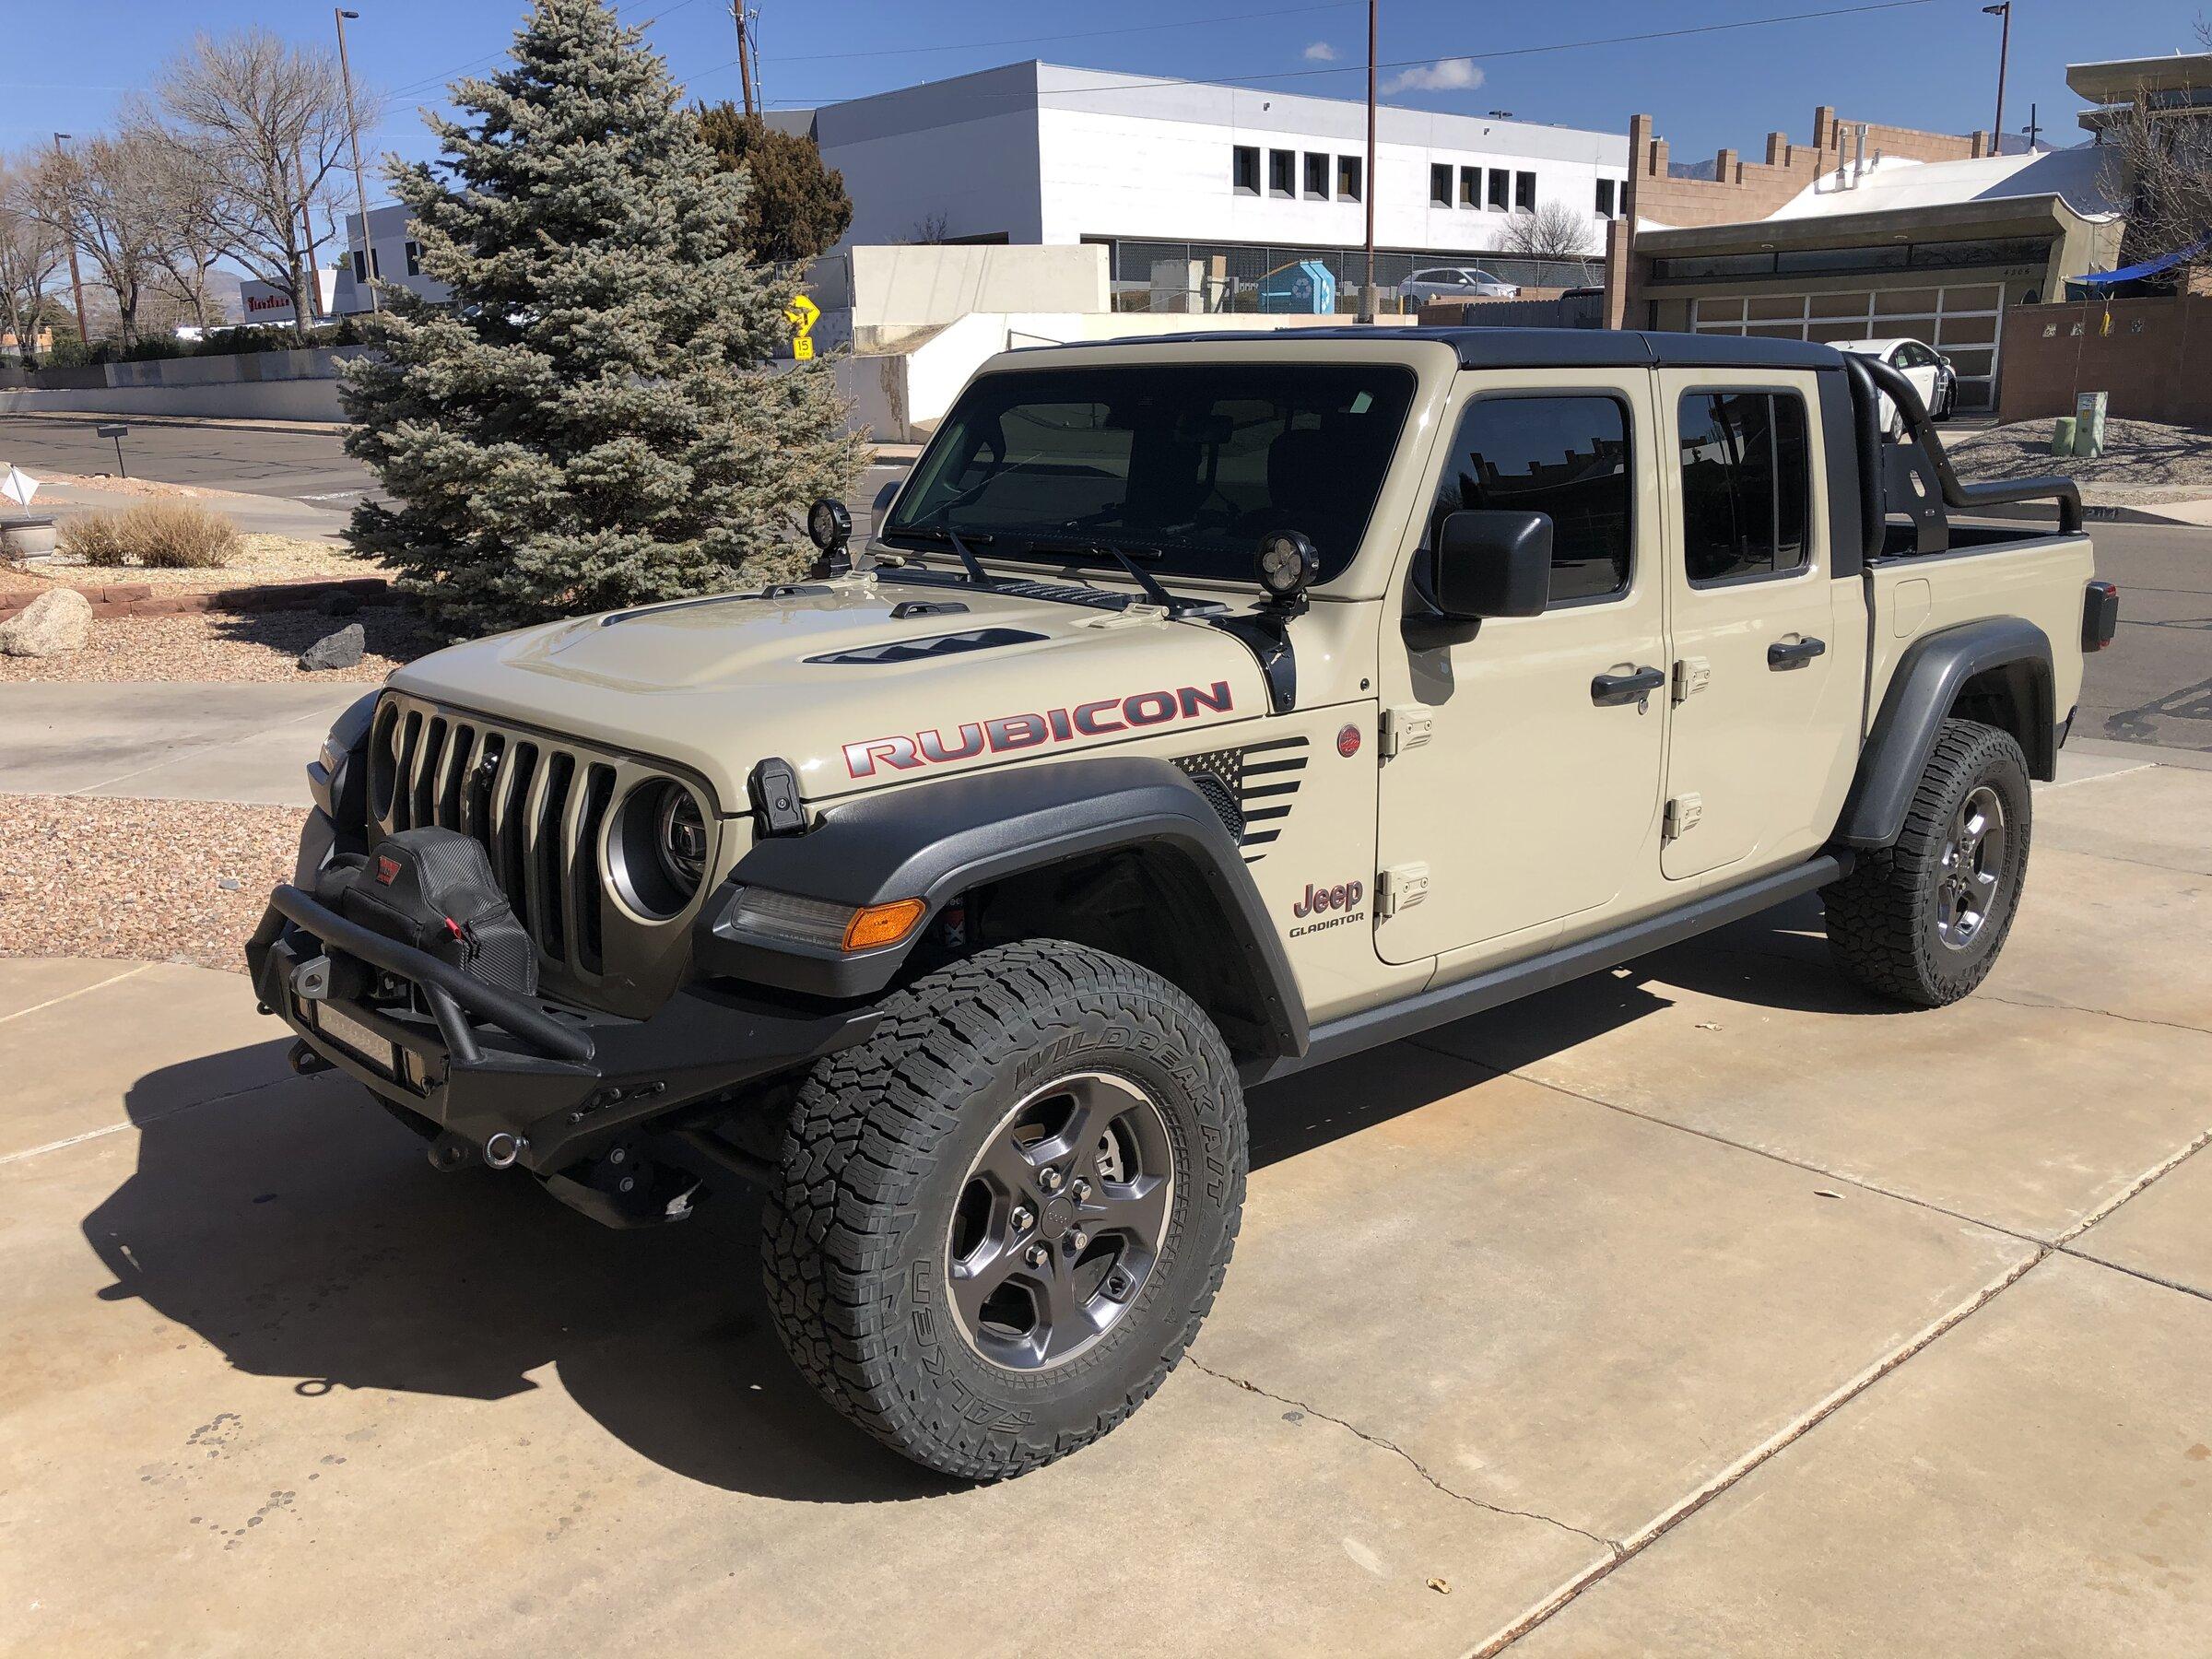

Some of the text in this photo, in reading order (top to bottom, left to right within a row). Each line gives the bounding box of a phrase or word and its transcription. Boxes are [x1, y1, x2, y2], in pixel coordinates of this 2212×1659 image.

[798, 340, 809, 351] 15
[841, 680, 1234, 780] RUBICON
[1289, 912, 1364, 938] GLADIATOR
[1293, 880, 1363, 919] Jeep
[1014, 1026, 1225, 1208] WILDPEAK A/T
[911, 1259, 1036, 1435] FALKEN
